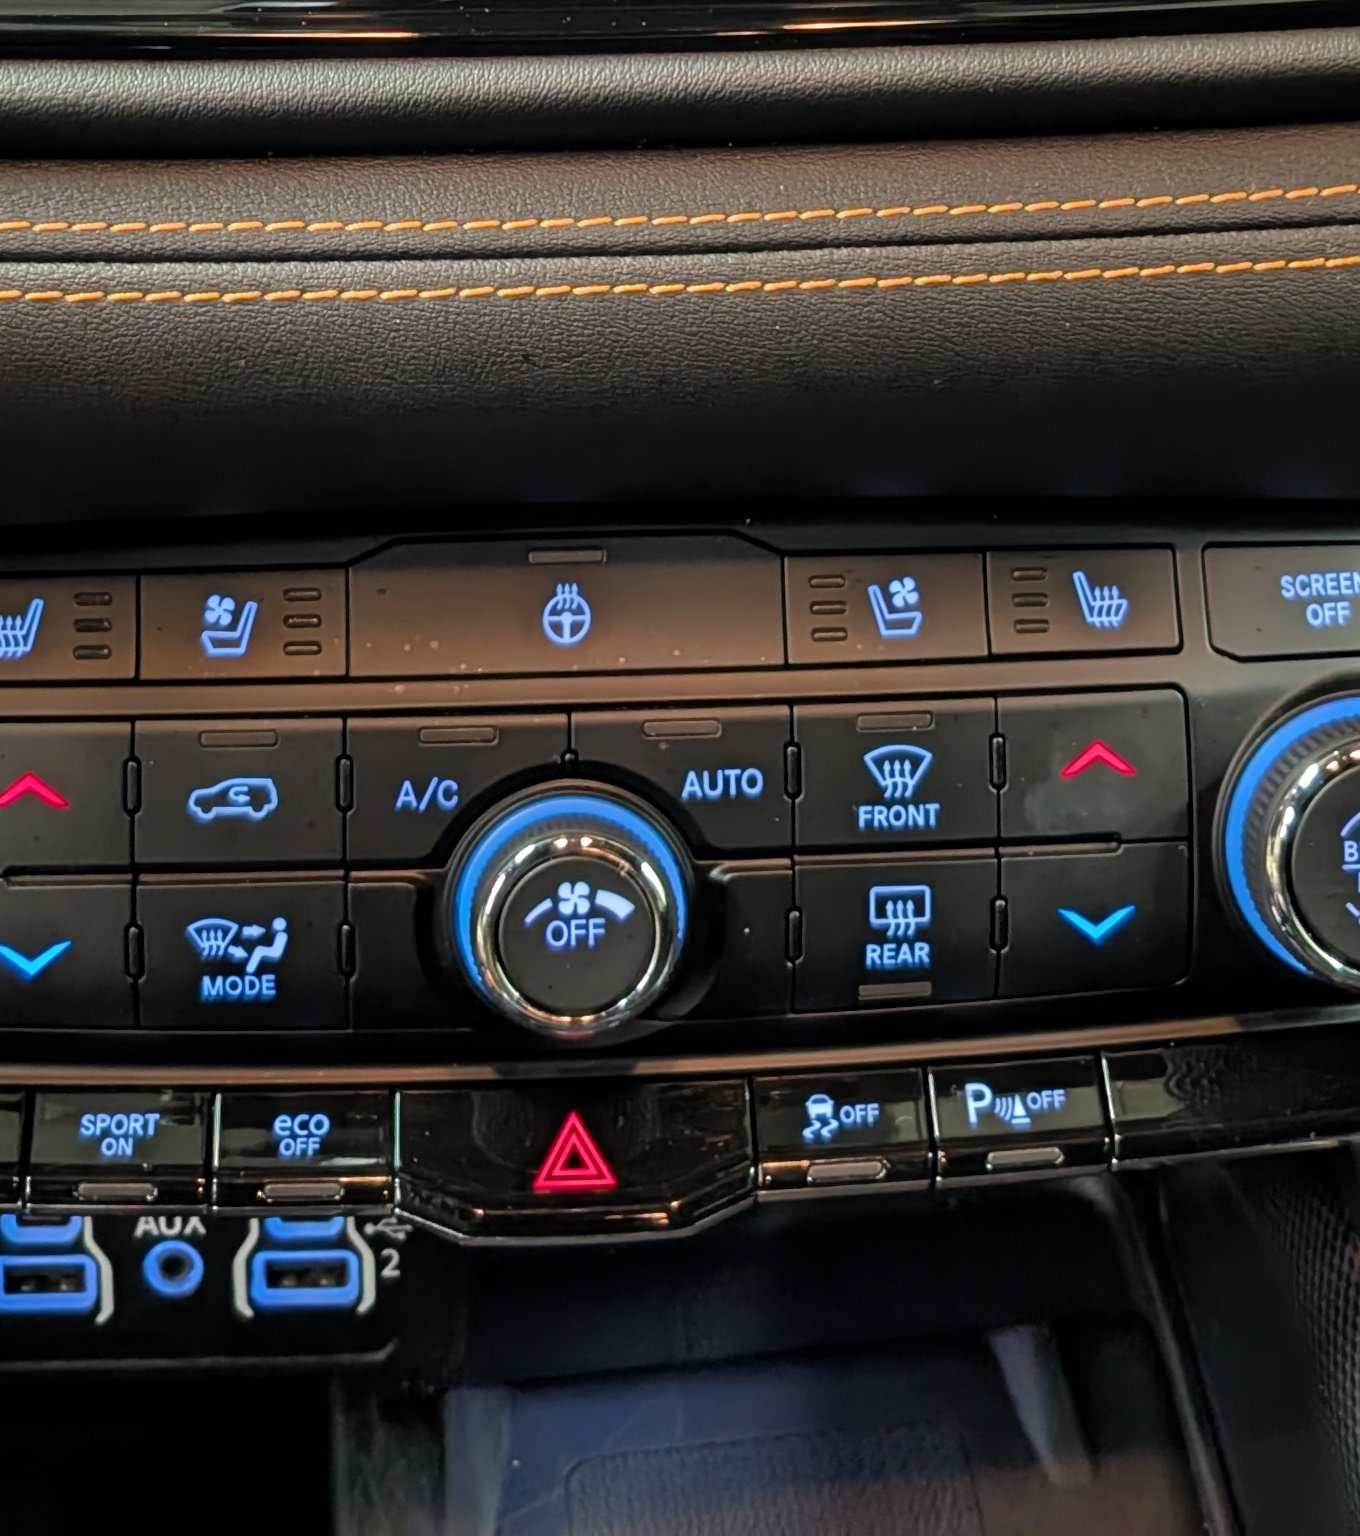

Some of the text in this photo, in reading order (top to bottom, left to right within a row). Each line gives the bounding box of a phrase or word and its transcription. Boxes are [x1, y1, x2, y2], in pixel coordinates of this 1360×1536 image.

[1306, 601, 1351, 627] OFF
[395, 776, 459, 811] A/C
[681, 767, 764, 800] AUTO
[858, 803, 940, 829] FRONT
[546, 917, 607, 951] OFF
[865, 941, 931, 968] REAR
[201, 974, 277, 1000] MODE
[1025, 1088, 1067, 1112] OFF
[79, 1113, 161, 1136] SPORT
[839, 1103, 881, 1129] OFF
[100, 1138, 134, 1157] ON
[279, 1138, 321, 1157] OFF
[380, 1247, 402, 1279] 2
